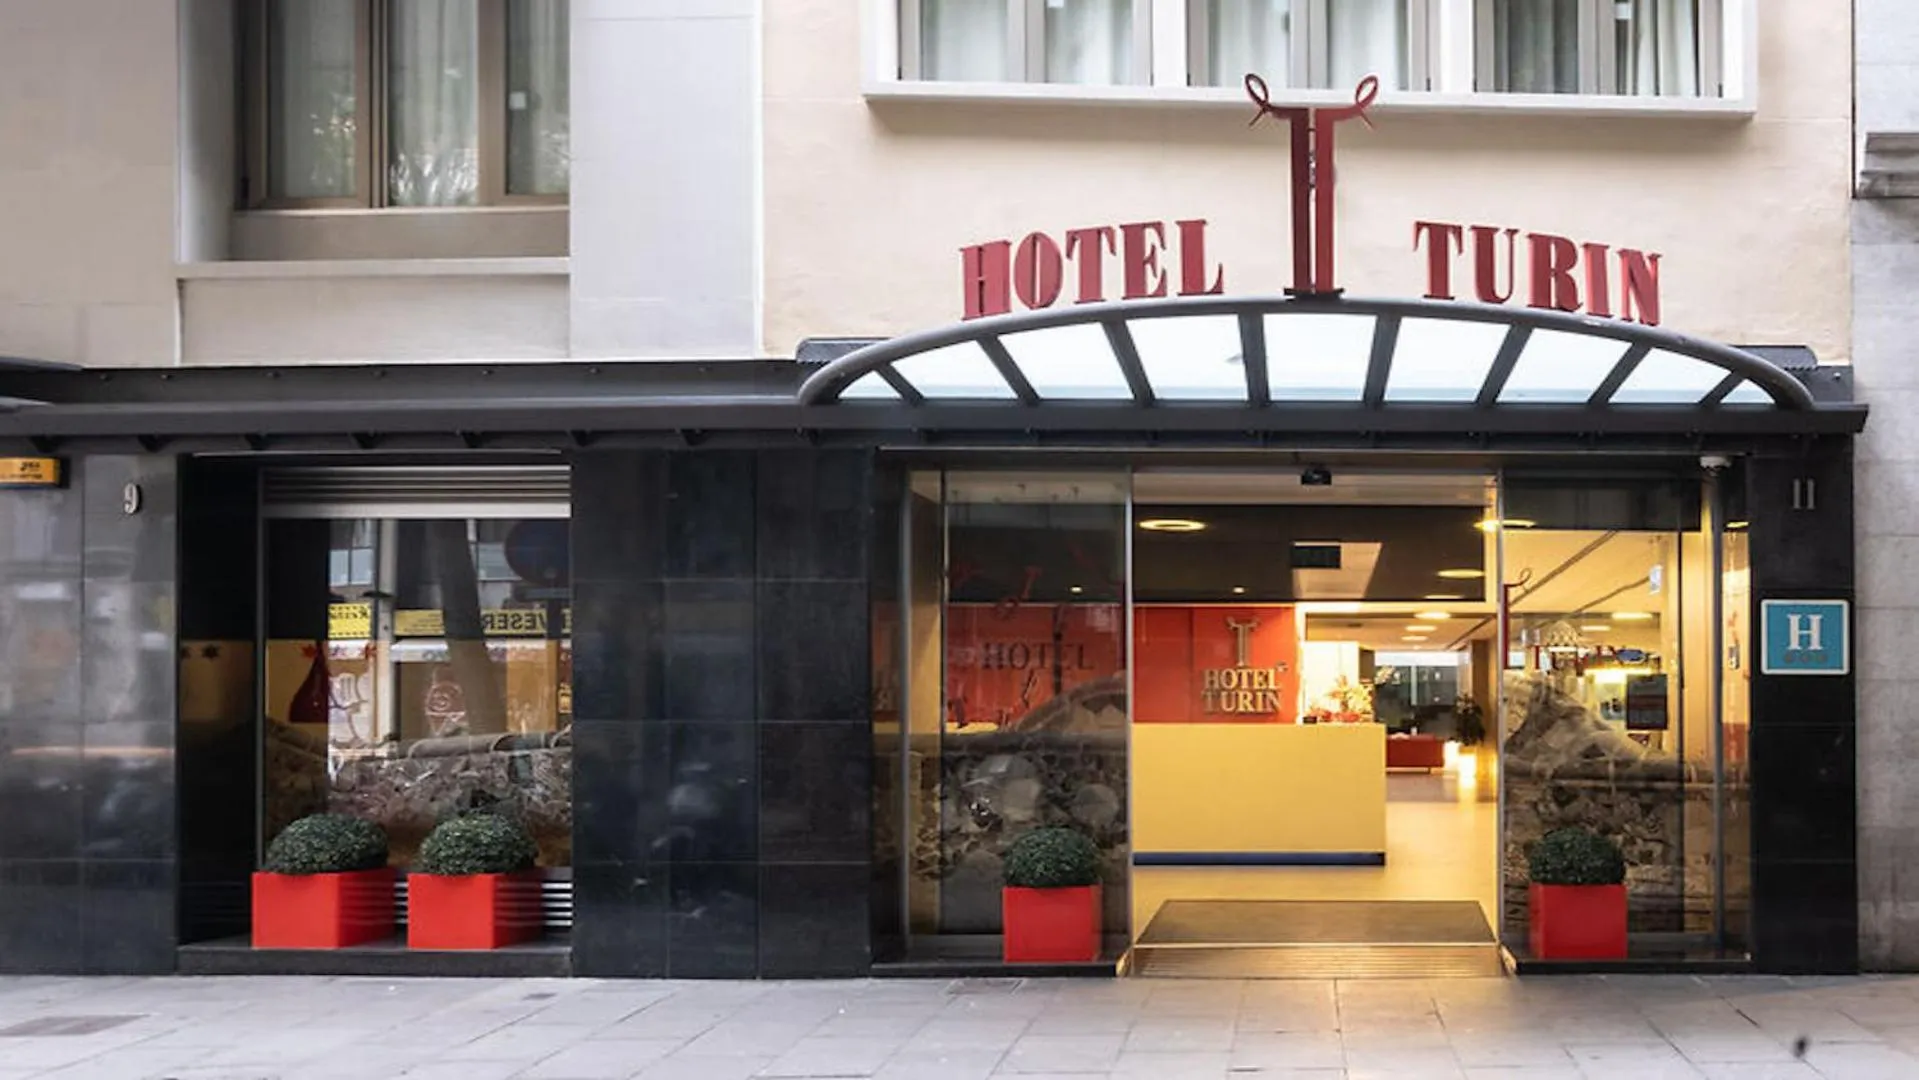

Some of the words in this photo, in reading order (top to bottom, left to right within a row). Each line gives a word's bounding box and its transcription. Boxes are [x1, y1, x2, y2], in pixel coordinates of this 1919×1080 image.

[959, 219, 1224, 320] HOTEL
[1413, 221, 1662, 326] TURIN
[124, 483, 138, 514] 9
[1787, 614, 1823, 650] H
[1204, 668, 1281, 690] HOTEL
[1202, 690, 1281, 713] TURIN
